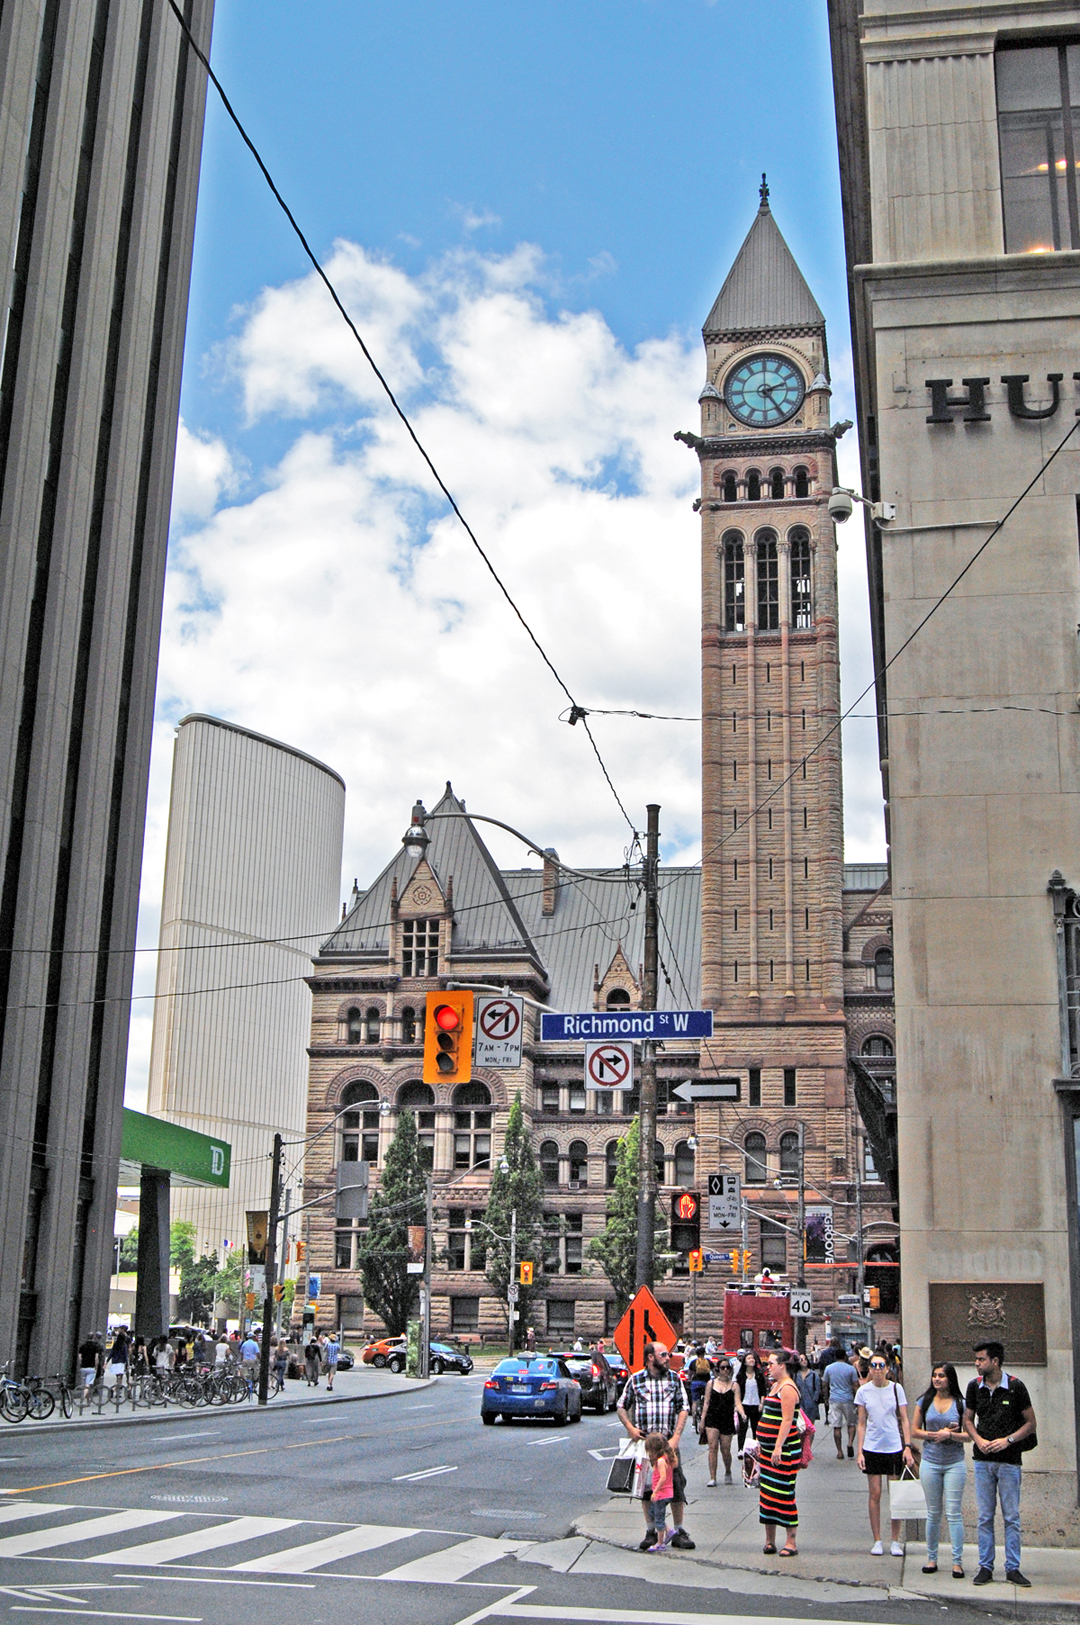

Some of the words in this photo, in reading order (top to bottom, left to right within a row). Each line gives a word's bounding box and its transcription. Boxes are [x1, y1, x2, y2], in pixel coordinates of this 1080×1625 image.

[925, 372, 1080, 424] HU
[563, 1015, 654, 1034] Richmond
[659, 1014, 669, 1024] St
[673, 1014, 689, 1032] W
[478, 1042, 494, 1052] 7AM
[504, 1042, 519, 1052] 7PM
[210, 1145, 224, 1176] TD
[824, 1216, 834, 1263] GROOVE
[791, 1300, 811, 1313] 40
